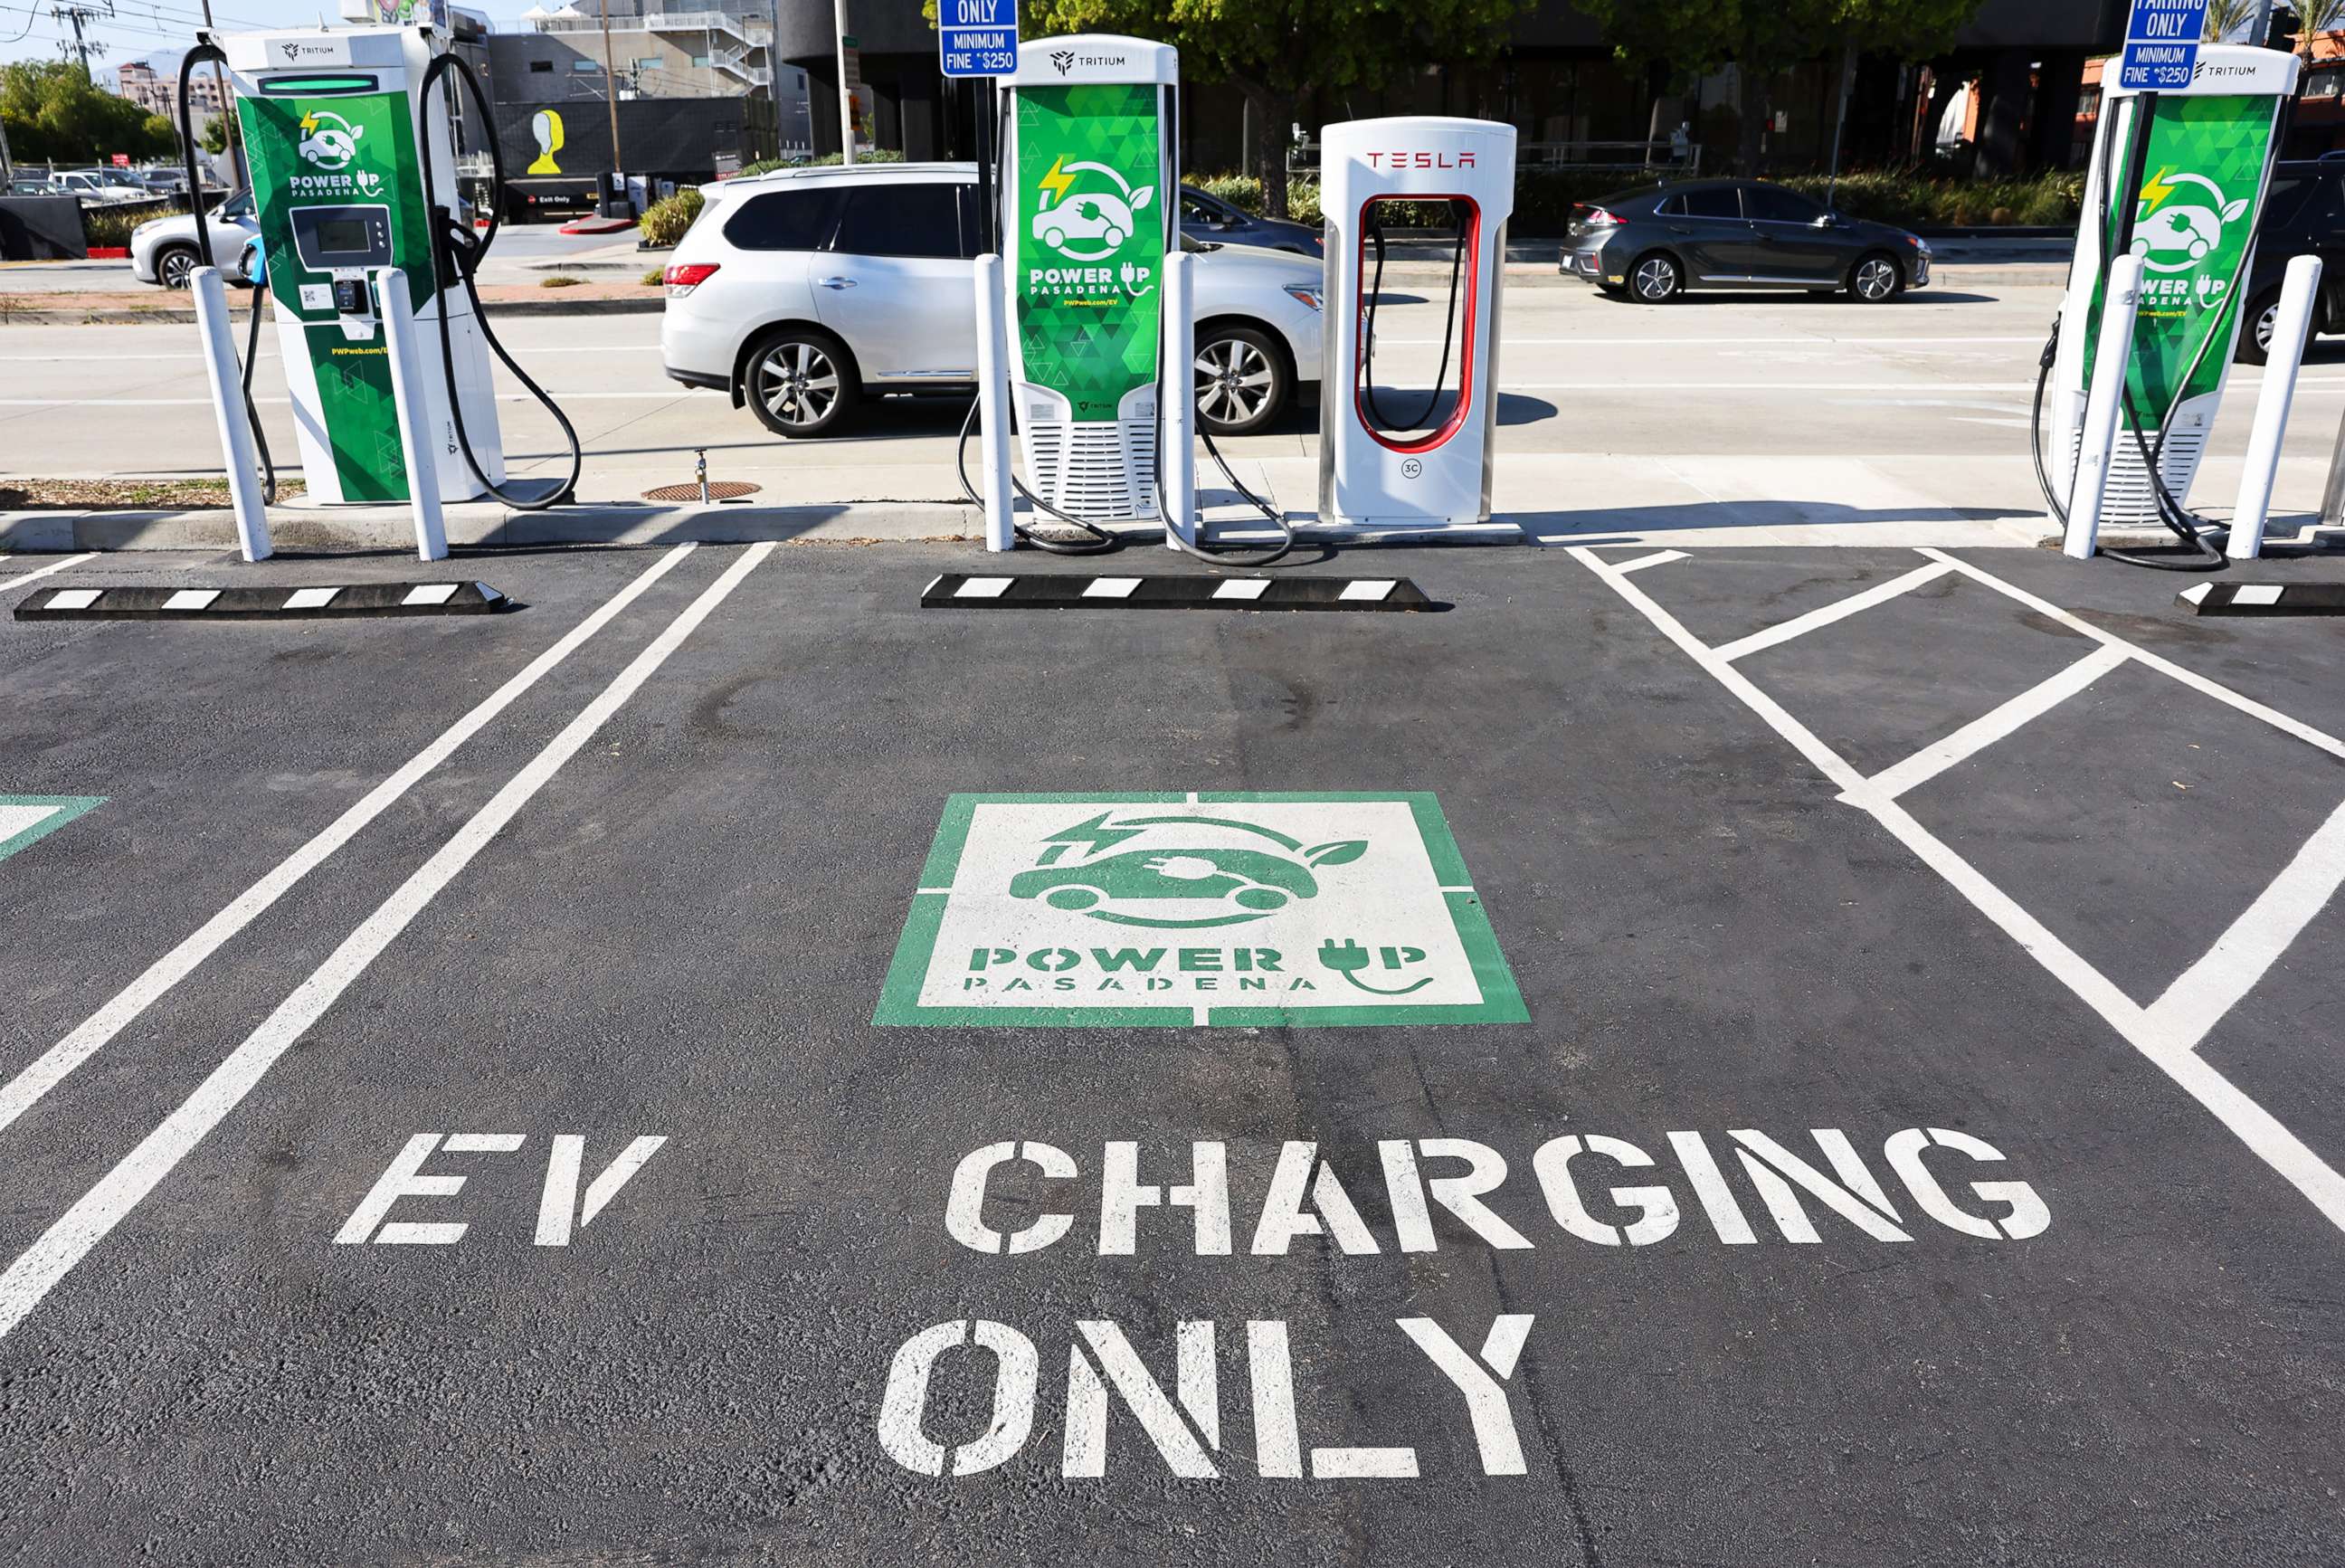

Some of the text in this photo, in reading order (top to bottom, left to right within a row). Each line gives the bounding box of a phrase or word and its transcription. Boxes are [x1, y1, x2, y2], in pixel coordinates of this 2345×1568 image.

[957, 0, 998, 24] ONLY
[2146, 13, 2188, 36] ONLY
[954, 33, 1005, 50] MINIMUM
[301, 46, 334, 54] TRITIUM
[2135, 47, 2186, 63] MINIMUM
[946, 52, 1013, 70] FINE $250
[1078, 57, 1125, 66] TRITIUM
[2123, 66, 2189, 84] FINE $250
[2208, 66, 2256, 76] TRITIUM
[1367, 152, 1476, 169] TESLA
[290, 175, 352, 189] POWER
[291, 187, 360, 197] PASADENA
[554, 195, 570, 204] Only
[1030, 268, 1113, 285] POWER
[1030, 284, 1121, 295] PASADENA
[2141, 279, 2189, 295] WER
[2138, 296, 2192, 306] ADENA
[331, 347, 388, 355] PWPweb.com/E
[1405, 463, 1419, 472] 3C
[968, 947, 1285, 972] POWER
[963, 977, 1316, 991] PASADENA
[331, 1127, 2051, 1256] EV CHARGING
[878, 1314, 1535, 1478] ONLY
